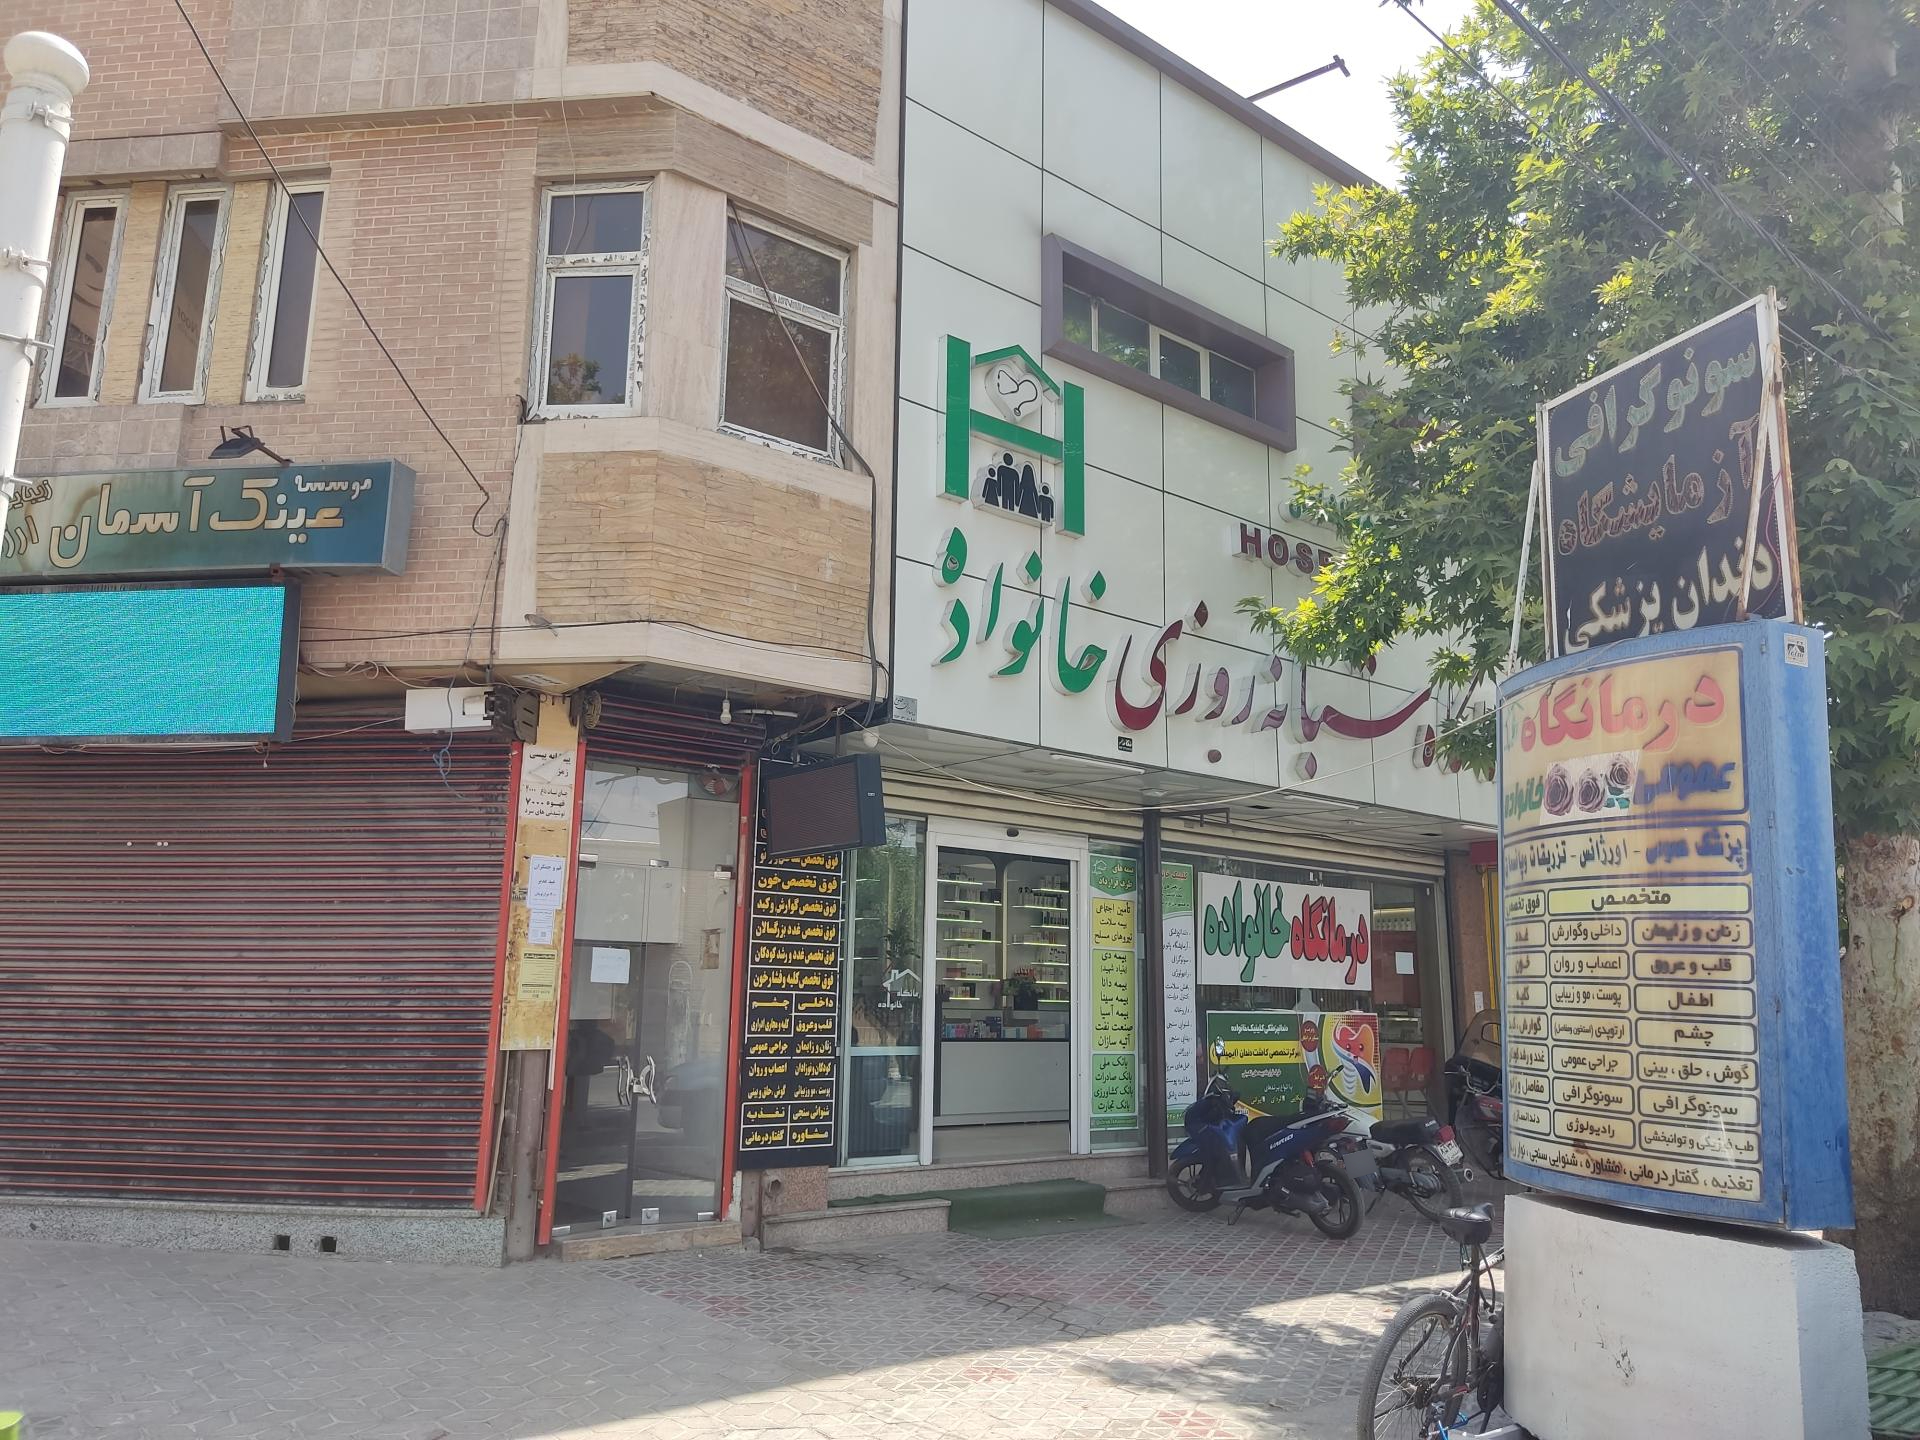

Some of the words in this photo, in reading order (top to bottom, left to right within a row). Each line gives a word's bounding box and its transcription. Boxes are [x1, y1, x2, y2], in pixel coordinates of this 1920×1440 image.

[1555, 343, 1756, 477] سونوگرافی
[208, 478, 345, 545] عینک
[48, 476, 216, 570] آسمان
[1672, 534, 1774, 630] دندان
[932, 525, 1108, 697] خانواده
[1563, 577, 1664, 654] پزشکی
[1520, 673, 1726, 752] درمانگاه
[757, 872, 782, 889] خون
[781, 875, 817, 890] تخصص
[818, 876, 838, 893] فوق
[798, 899, 824, 915] تخصص
[1591, 887, 1672, 912] متخصص
[823, 900, 837, 917] فوق
[801, 923, 824, 939] تخصص
[823, 924, 836, 941] فوق
[1203, 880, 1291, 983] خانواده
[1291, 893, 1369, 986] درمانگاه
[1590, 922, 1622, 940] داخلی
[804, 947, 824, 964] تخصص
[823, 948, 835, 966] فوق
[1553, 955, 1576, 974] روان
[1577, 959, 1584, 974] و
[1585, 955, 1622, 974] اعصاب
[1688, 960, 1698, 975] و
[1701, 957, 1733, 976] قلب
[798, 971, 821, 989] تخصص
[821, 971, 834, 990] فوق
[1114, 981, 1128, 992] بیمه
[751, 996, 790, 1011] چشم
[797, 996, 834, 1011] داخلی
[1115, 994, 1129, 1006] بیمه
[1582, 990, 1591, 1005] مو
[1668, 991, 1714, 1011] اطفال
[1115, 1010, 1129, 1020] بیمه
[818, 1016, 833, 1032] قلب
[1111, 1022, 1134, 1032] صنعت
[1594, 1024, 1625, 1041] ارتوپدی
[1673, 1024, 1715, 1047] چشم
[768, 1039, 789, 1055] جراحی
[1099, 1057, 1110, 1070] ملی
[1112, 1055, 1128, 1070] بانک
[1561, 1055, 1587, 1069] عمومی
[1588, 1054, 1618, 1072] جراحی
[1643, 1061, 1669, 1079] بینی
[1095, 1071, 1117, 1084] صادرات
[1119, 1071, 1133, 1084] بانک
[1678, 1062, 1703, 1080] حلق
[1713, 1063, 1750, 1084] گوش
[1093, 1086, 1119, 1099] کشاورزی
[1119, 1085, 1134, 1098] بانک
[1562, 1085, 1624, 1107] سونوگرافی
[746, 1106, 785, 1122] تغذیه
[1097, 1100, 1115, 1112] تجارت
[1116, 1099, 1130, 1112] بانک
[1652, 1095, 1738, 1118] سونوگرافی
[791, 1127, 829, 1143] مشاوره
[1566, 1117, 1615, 1138] رادیولوژی
[1688, 1138, 1695, 1150] و
[1734, 1140, 1754, 1155] طب
[1549, 1153, 1578, 1171] شنوایی
[1584, 1157, 1623, 1176] مشاوره
[1711, 1177, 1754, 1195] تغذیه
